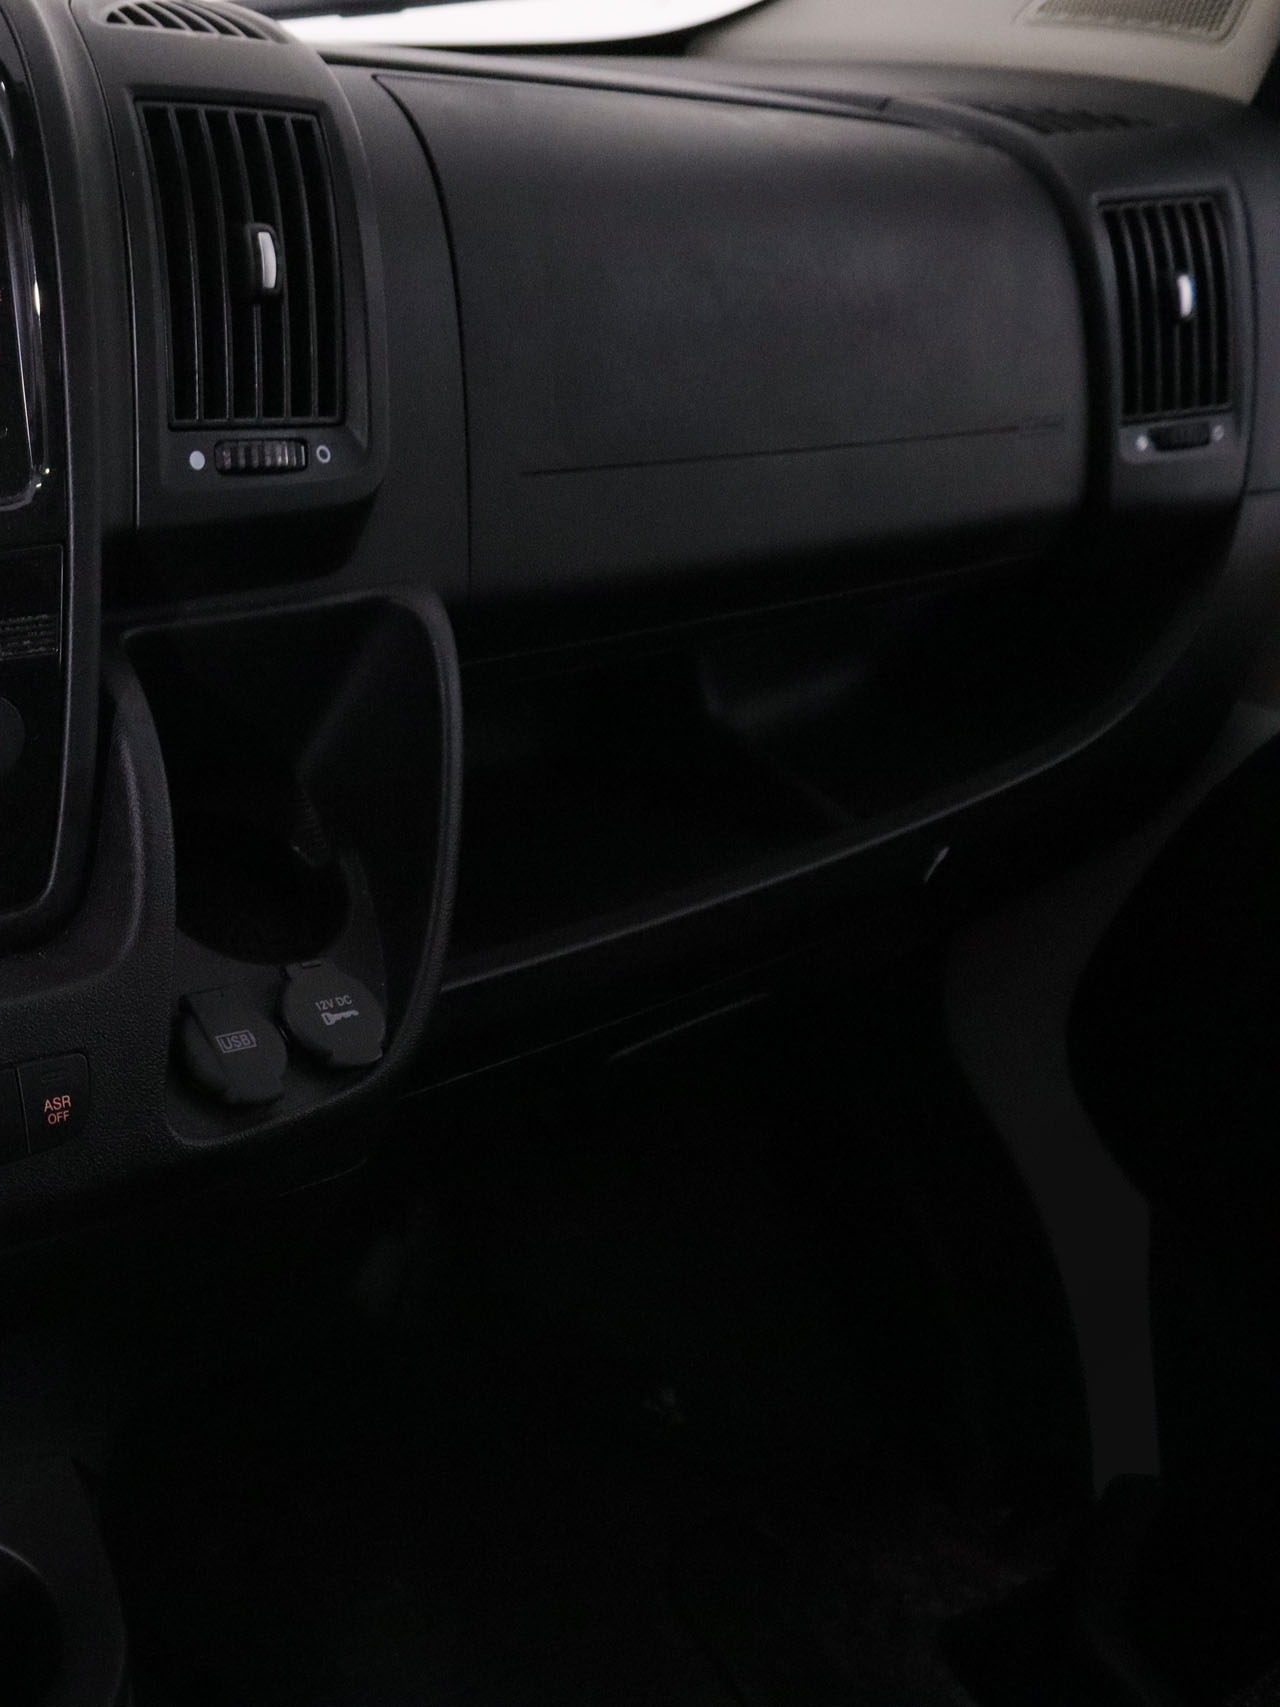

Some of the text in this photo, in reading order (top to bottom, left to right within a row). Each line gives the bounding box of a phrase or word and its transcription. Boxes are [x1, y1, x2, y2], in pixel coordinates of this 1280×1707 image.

[314, 994, 353, 1011] 12V DC
[220, 1032, 252, 1050] USB
[43, 1094, 72, 1113] ASR
[47, 1110, 70, 1125] OFF
